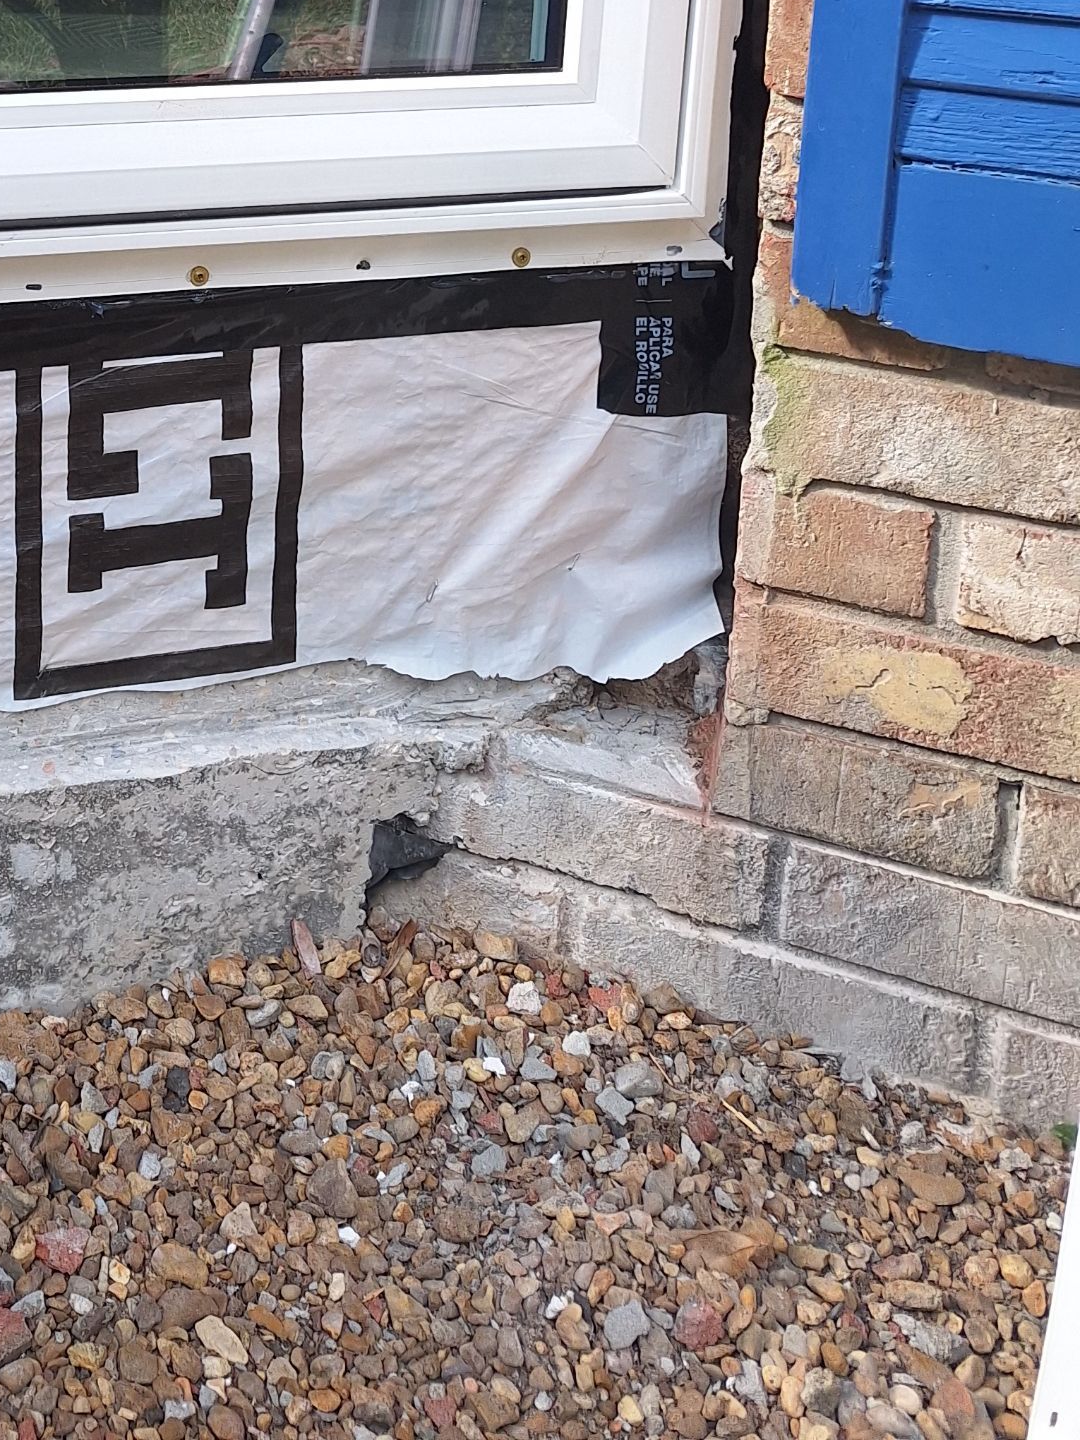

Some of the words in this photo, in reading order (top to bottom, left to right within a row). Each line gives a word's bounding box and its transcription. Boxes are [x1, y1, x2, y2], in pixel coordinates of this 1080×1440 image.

[635, 317, 647, 336] EL
[661, 317, 674, 358] PARA
[649, 317, 662, 379] APLICAR
[645, 384, 660, 414] USE
